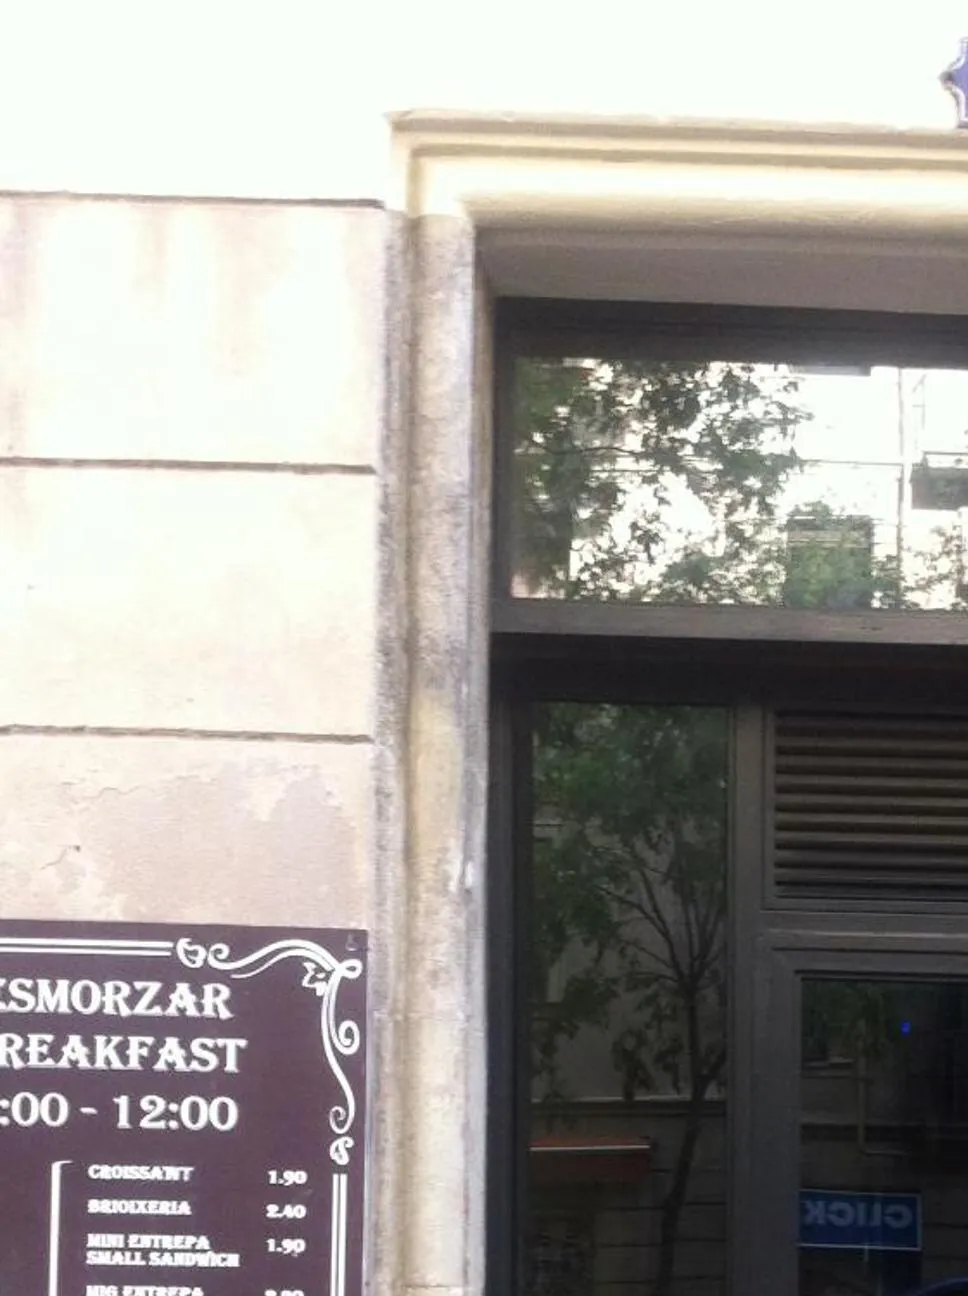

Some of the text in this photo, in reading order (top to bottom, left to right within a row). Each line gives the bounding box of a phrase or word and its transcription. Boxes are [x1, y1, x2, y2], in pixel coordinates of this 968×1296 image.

[113, 1095, 238, 1131] 12:00
[88, 1165, 307, 1186] CROISSANT 1.90
[266, 1204, 306, 1218] 2.40
[86, 1234, 306, 1253] MINI ENTREPA 1.90
[86, 1249, 240, 1267] SMALL SANDWICH
